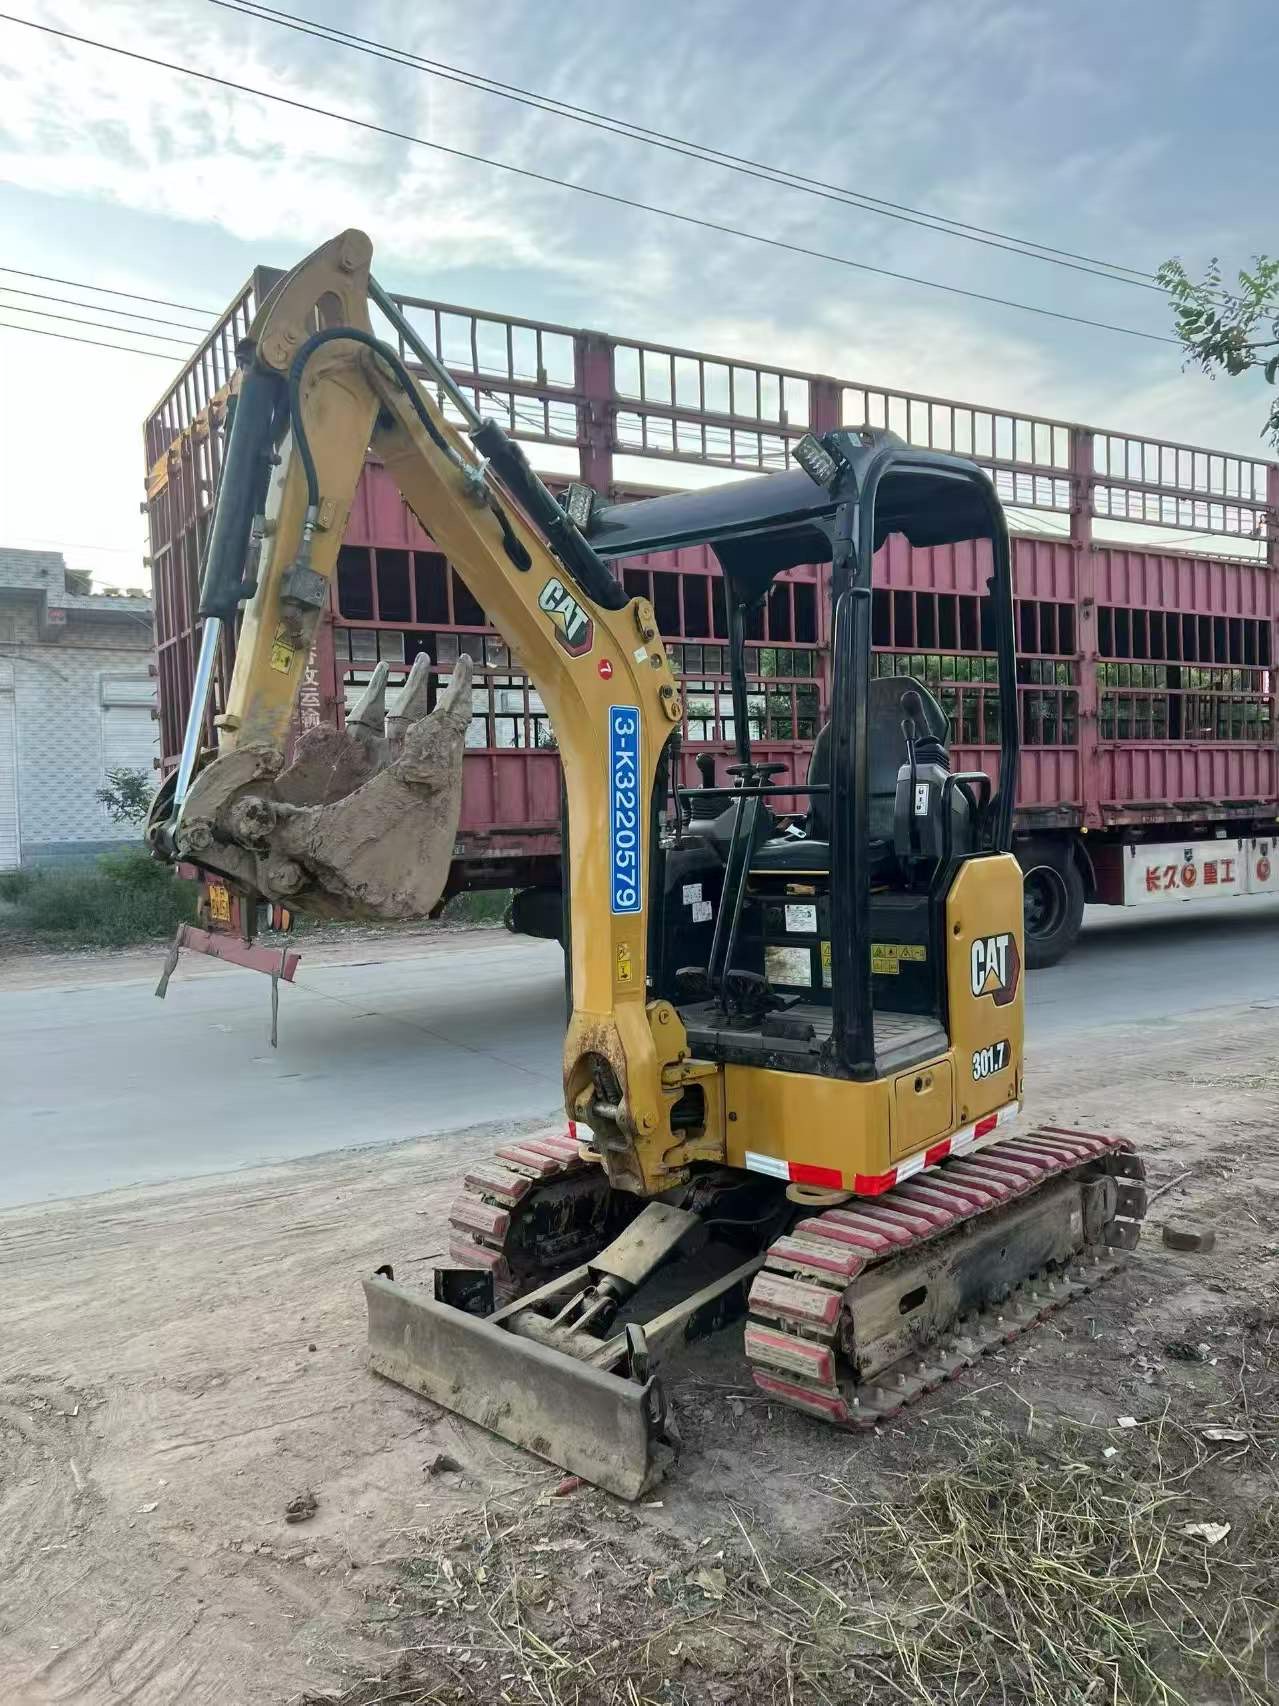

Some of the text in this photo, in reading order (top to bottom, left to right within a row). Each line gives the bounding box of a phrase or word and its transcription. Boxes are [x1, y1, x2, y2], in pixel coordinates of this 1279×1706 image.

[540, 578, 589, 641] CAT
[600, 662, 612, 673] 7
[614, 716, 636, 907] 3-K3220579
[1203, 858, 1236, 885] 重工
[971, 934, 1009, 996] CAT
[972, 1041, 1006, 1080] 301.7
